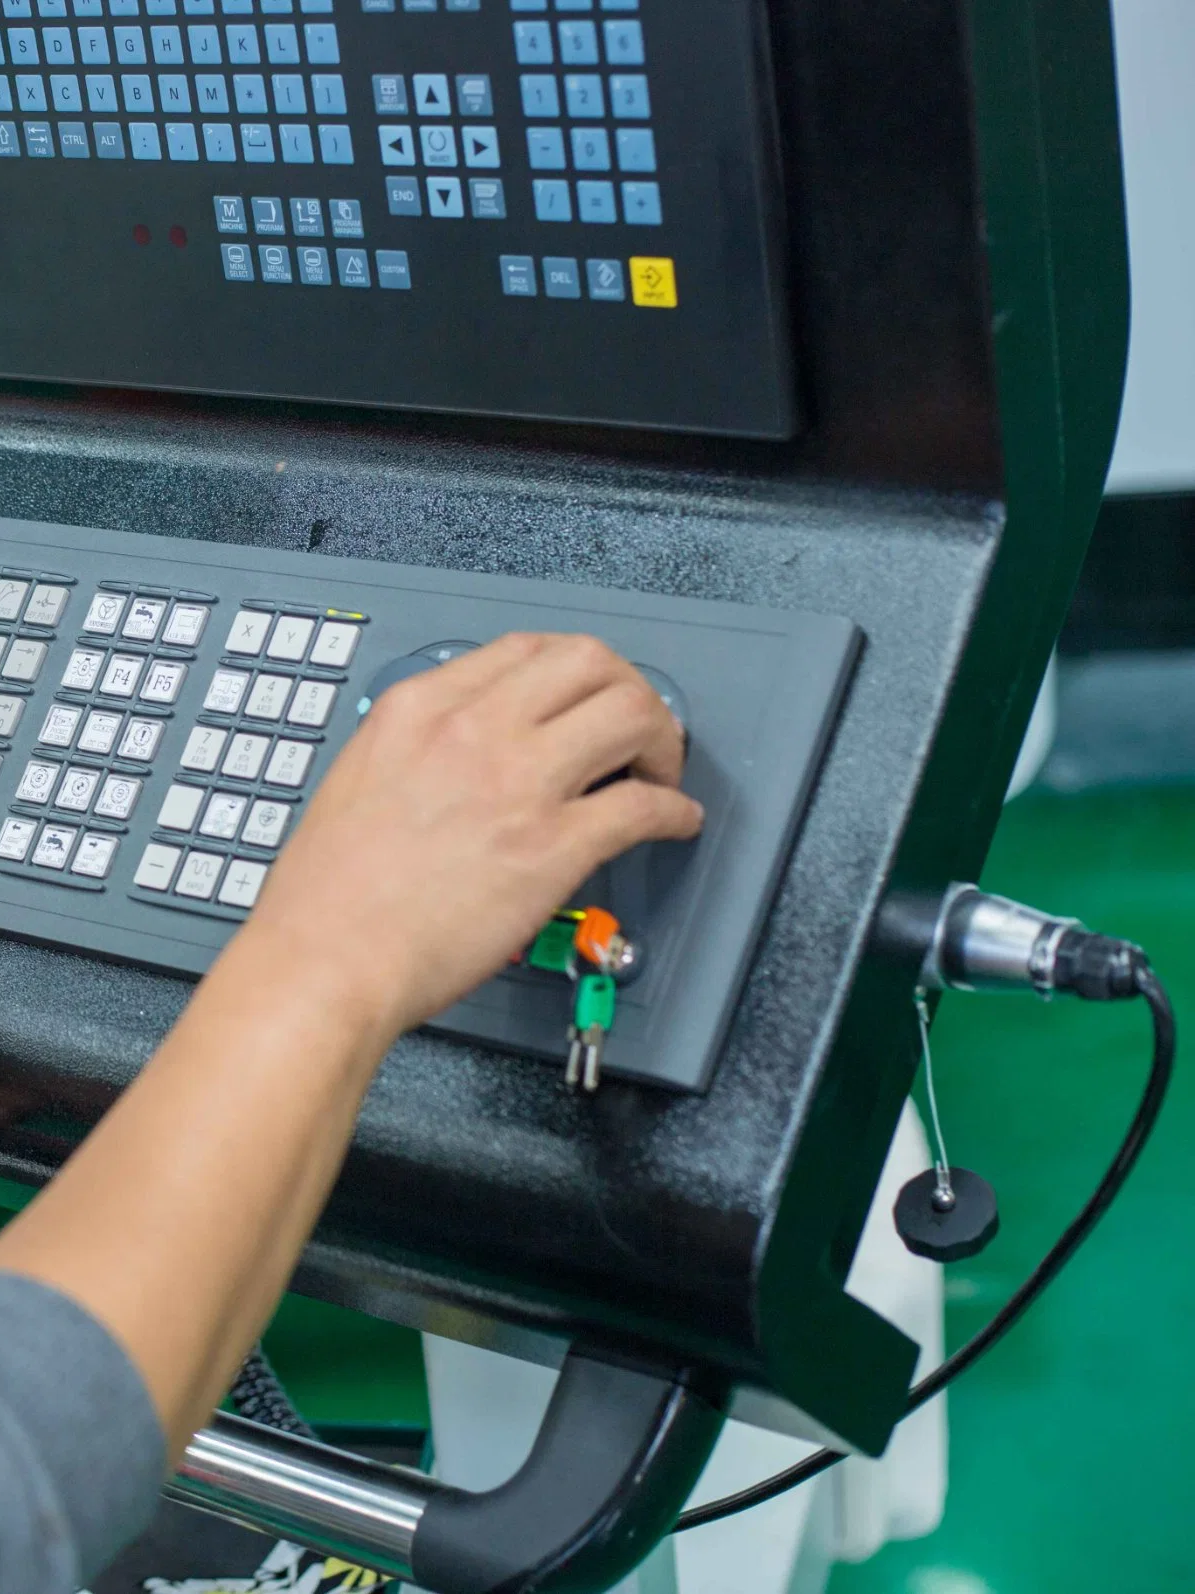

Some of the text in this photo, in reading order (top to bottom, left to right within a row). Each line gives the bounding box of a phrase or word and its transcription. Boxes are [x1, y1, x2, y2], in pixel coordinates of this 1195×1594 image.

[18, 40, 27, 53] S
[53, 40, 63, 52] D
[90, 39, 97, 52] F
[124, 39, 135, 52] G
[162, 38, 172, 52] H
[201, 38, 209, 52] J
[238, 38, 248, 52] K
[278, 37, 285, 51] L
[26, 87, 36, 100] X
[61, 87, 70, 100] C
[96, 87, 105, 100] V
[133, 87, 142, 100] B
[169, 87, 180, 100] N
[206, 87, 218, 101] M
[62, 134, 86, 146] CTRL
[100, 134, 117, 146] ALT
[34, 147, 47, 155] TAB
[392, 190, 415, 202] END
[219, 222, 245, 232] MACHINE
[256, 223, 285, 232] PROGRAM
[298, 224, 319, 234] OFFSET
[229, 263, 247, 272] MENU
[267, 264, 285, 273] MENU
[305, 266, 323, 275] MENU
[380, 265, 406, 274] CUSTOM
[229, 270, 249, 279] SELECT
[263, 271, 292, 281] FUNCTION
[308, 273, 324, 282] USER
[344, 275, 366, 284] ALARM
[550, 271, 573, 284] DEL
[241, 623, 254, 638] X
[287, 631, 297, 644] Y
[327, 636, 340, 650] Z
[111, 667, 132, 686] F4
[152, 674, 175, 692] F5
[267, 680, 276, 692] 4
[309, 686, 320, 699] 5
[203, 732, 212, 744] 7
[243, 739, 253, 752] 8
[287, 746, 297, 759] 9
